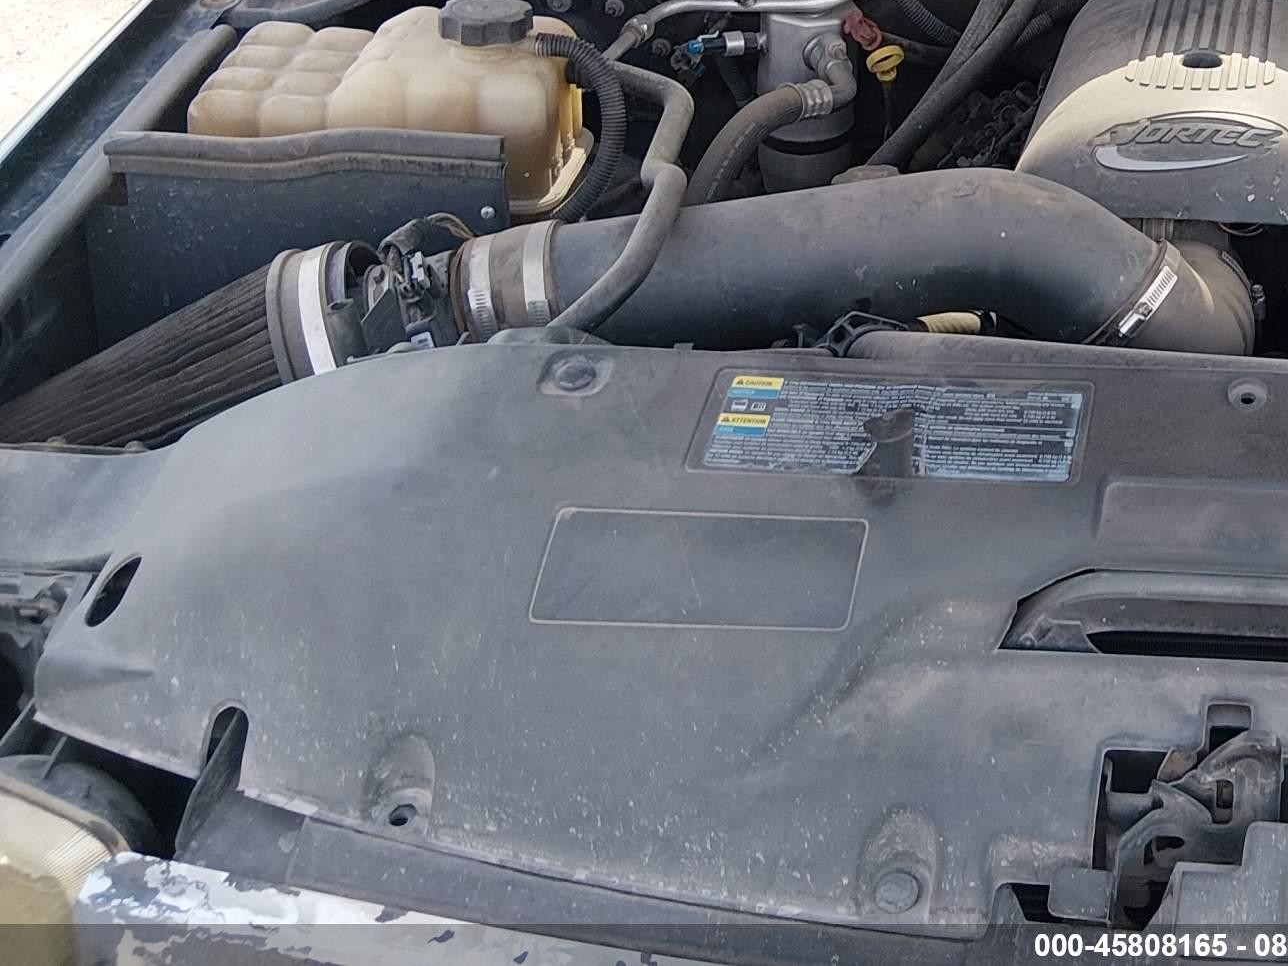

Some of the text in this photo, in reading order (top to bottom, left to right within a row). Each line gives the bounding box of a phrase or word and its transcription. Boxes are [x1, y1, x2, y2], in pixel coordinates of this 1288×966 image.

[1100, 121, 1282, 149] VORTEC
[744, 379, 773, 387] CAUTION
[730, 416, 767, 425] ATTENTION
